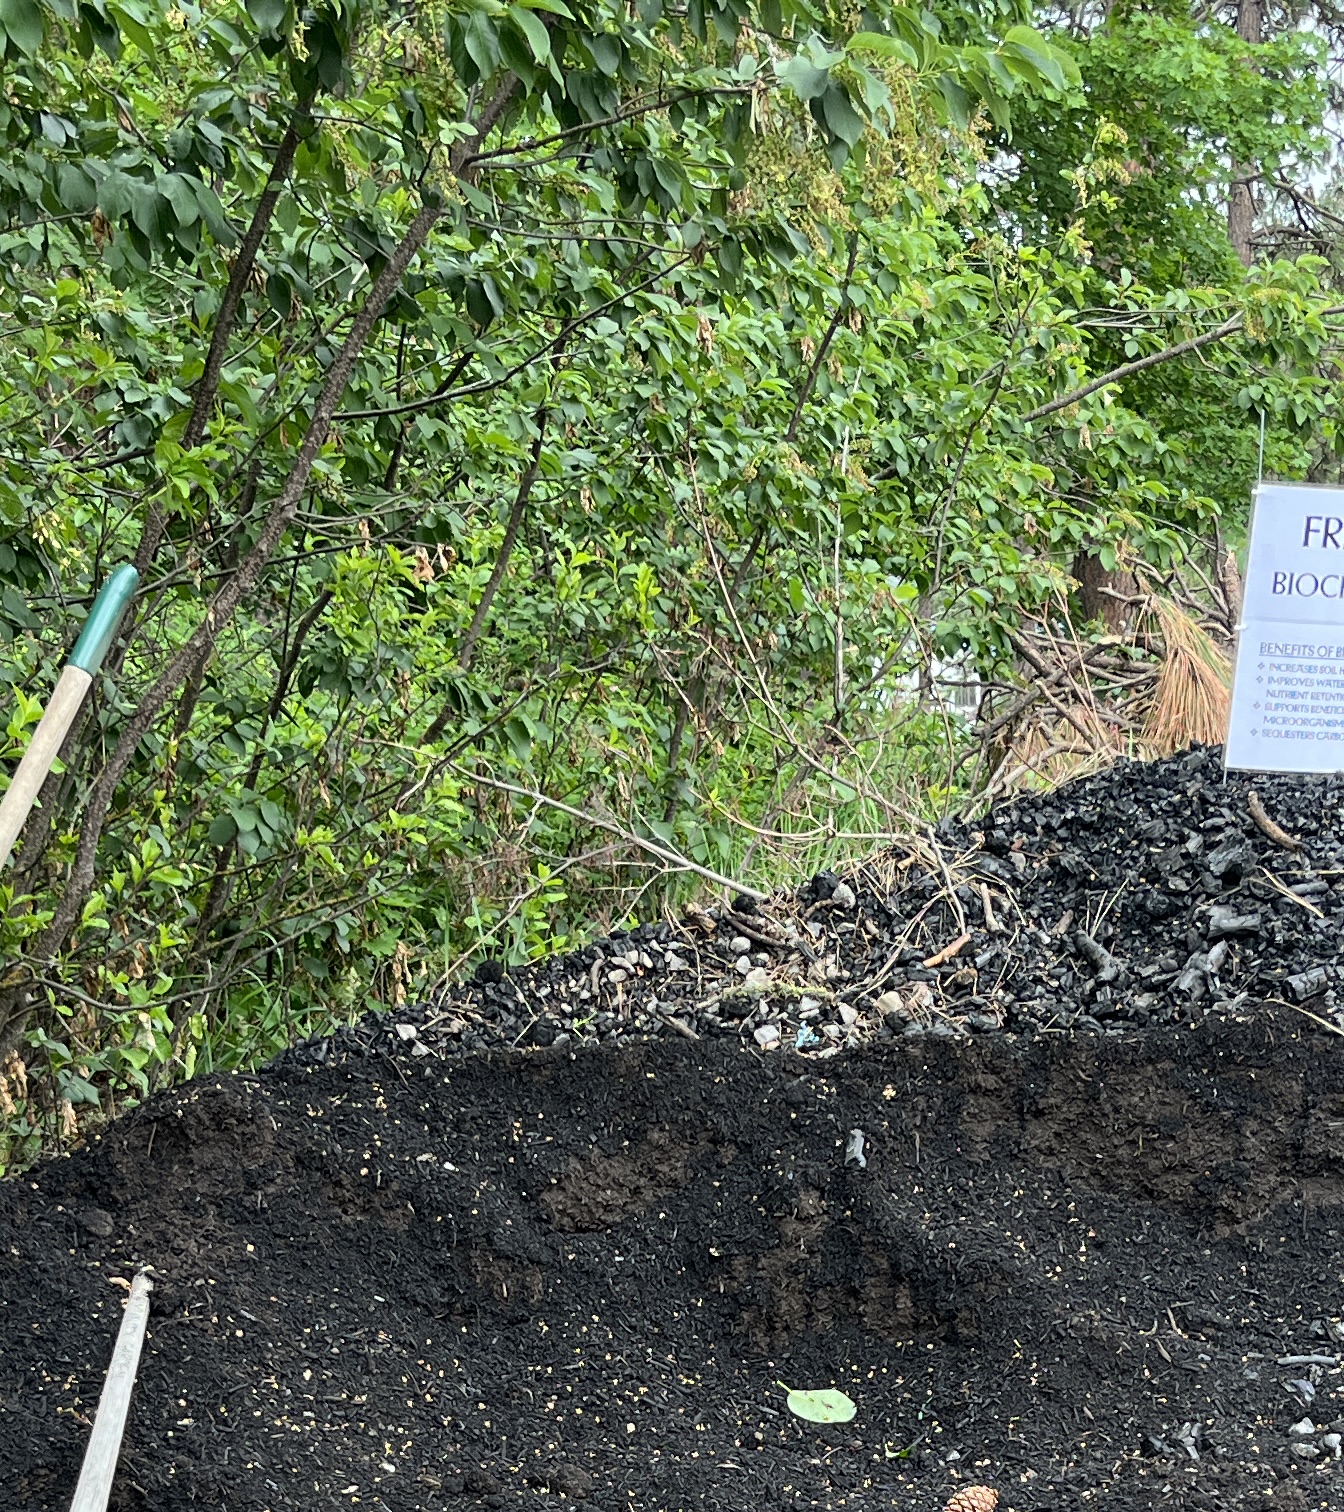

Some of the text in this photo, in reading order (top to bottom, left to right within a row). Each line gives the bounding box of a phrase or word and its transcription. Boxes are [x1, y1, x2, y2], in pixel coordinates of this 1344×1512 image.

[1260, 642, 1315, 656] BENEFITS
[1317, 646, 1334, 657] OF
[1269, 663, 1318, 674] INCREASES
[1319, 665, 1337, 675] SOIL
[1267, 676, 1314, 687] IMPROVES
[1266, 689, 1309, 699] NUTRIENT
[1265, 702, 1309, 713] SUPPORTS
[1262, 729, 1315, 740] SEQUESTERS
